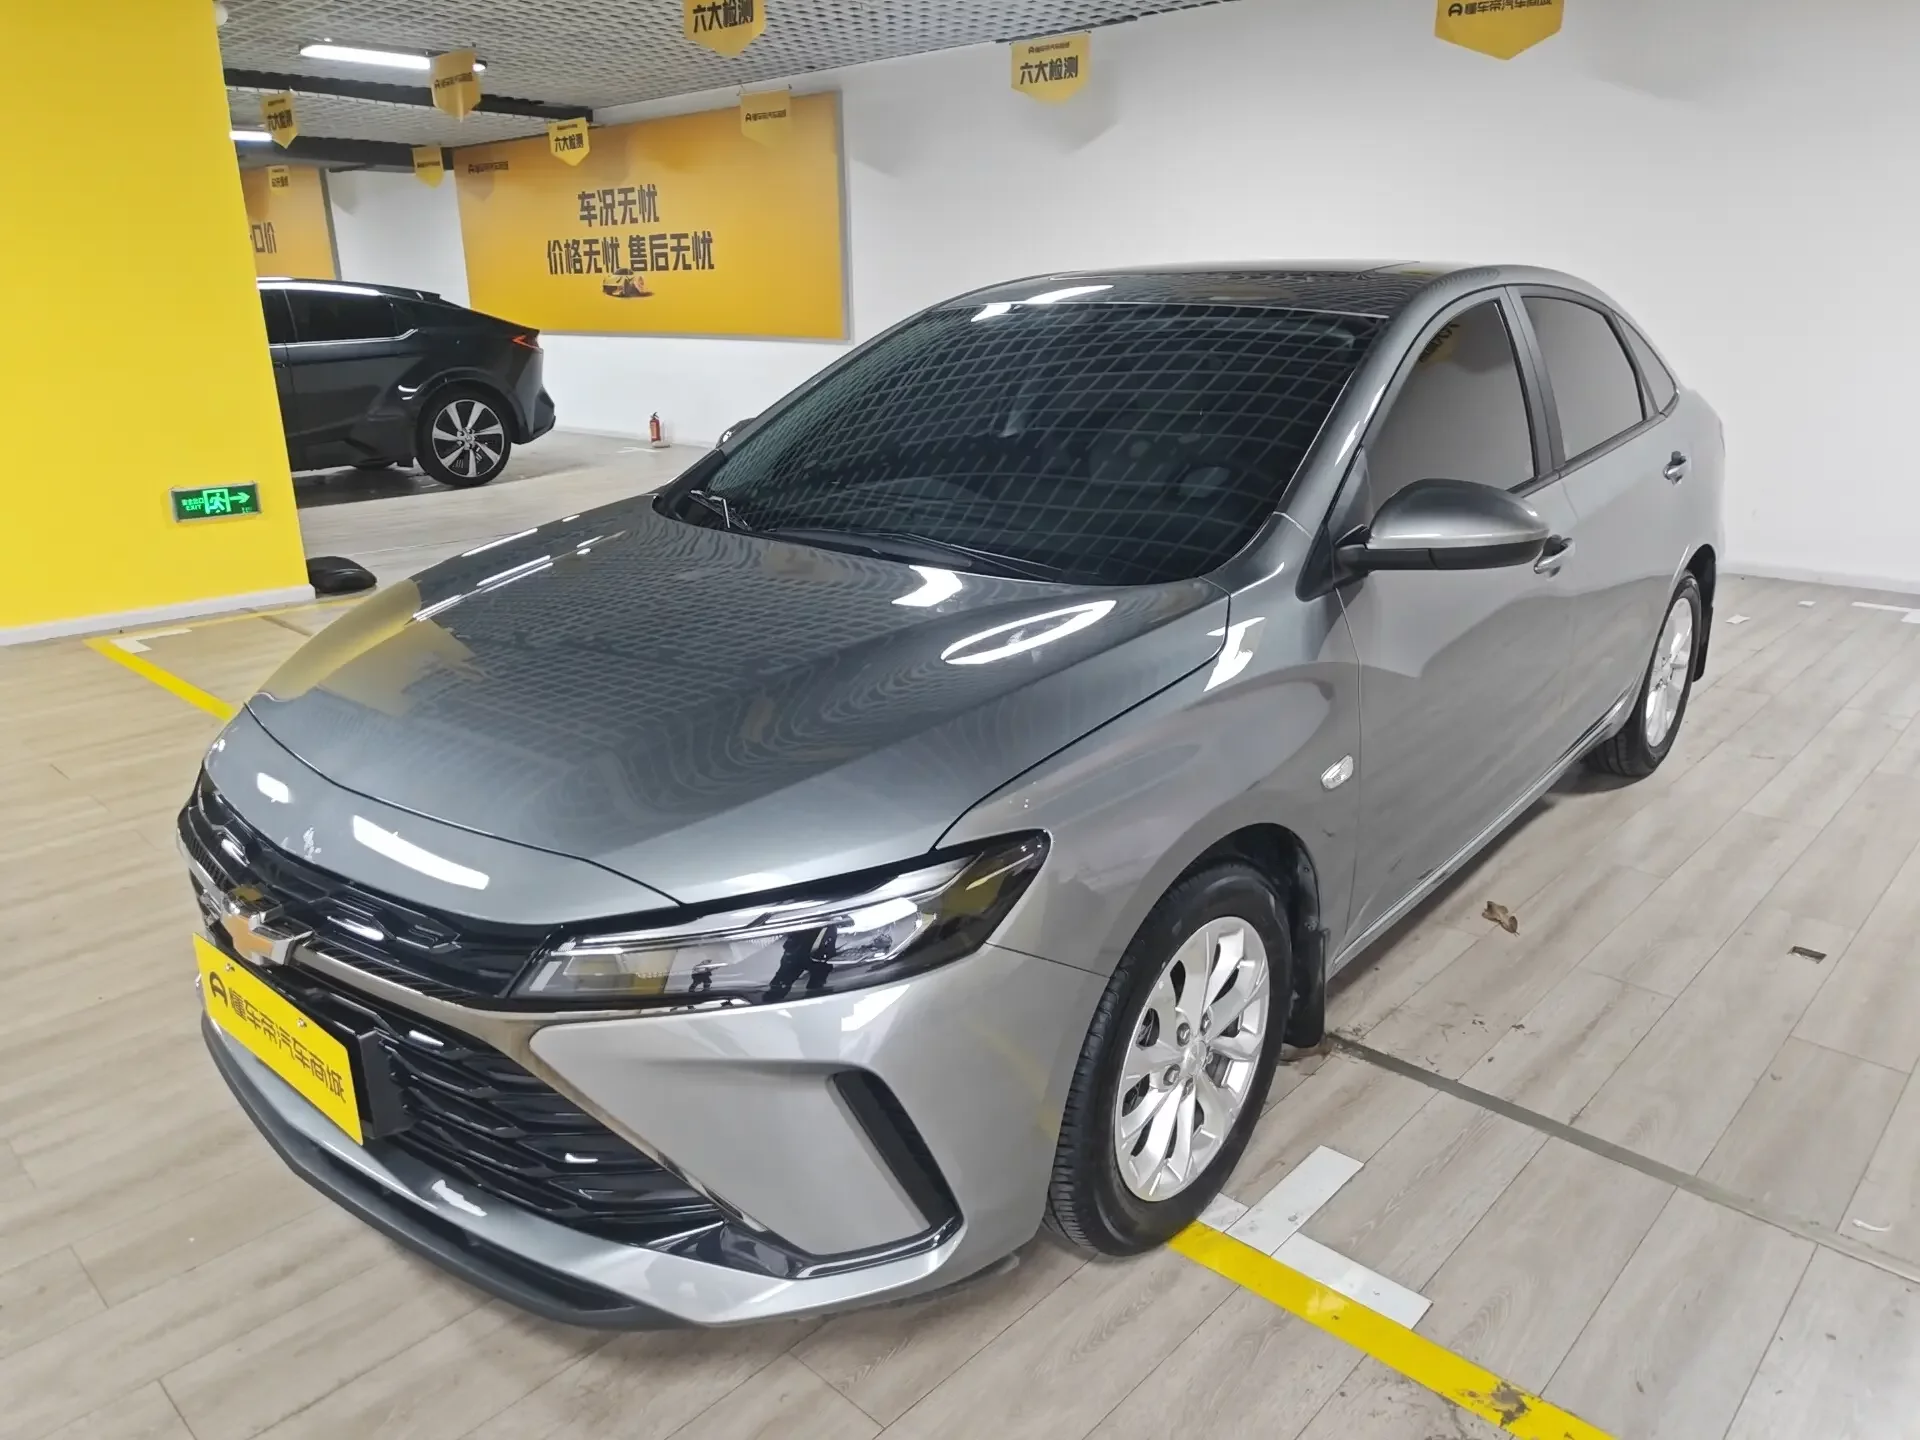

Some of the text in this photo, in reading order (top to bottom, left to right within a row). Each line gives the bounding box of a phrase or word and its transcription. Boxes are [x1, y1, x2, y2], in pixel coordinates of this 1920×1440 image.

[693, 0, 754, 33] 六大检测
[1020, 55, 1079, 85] 六大检测
[578, 184, 659, 227] 车况无忧
[547, 231, 715, 275] 价格无忧 售后无忧
[229, 988, 346, 1103] 懂车帝汽车商城
